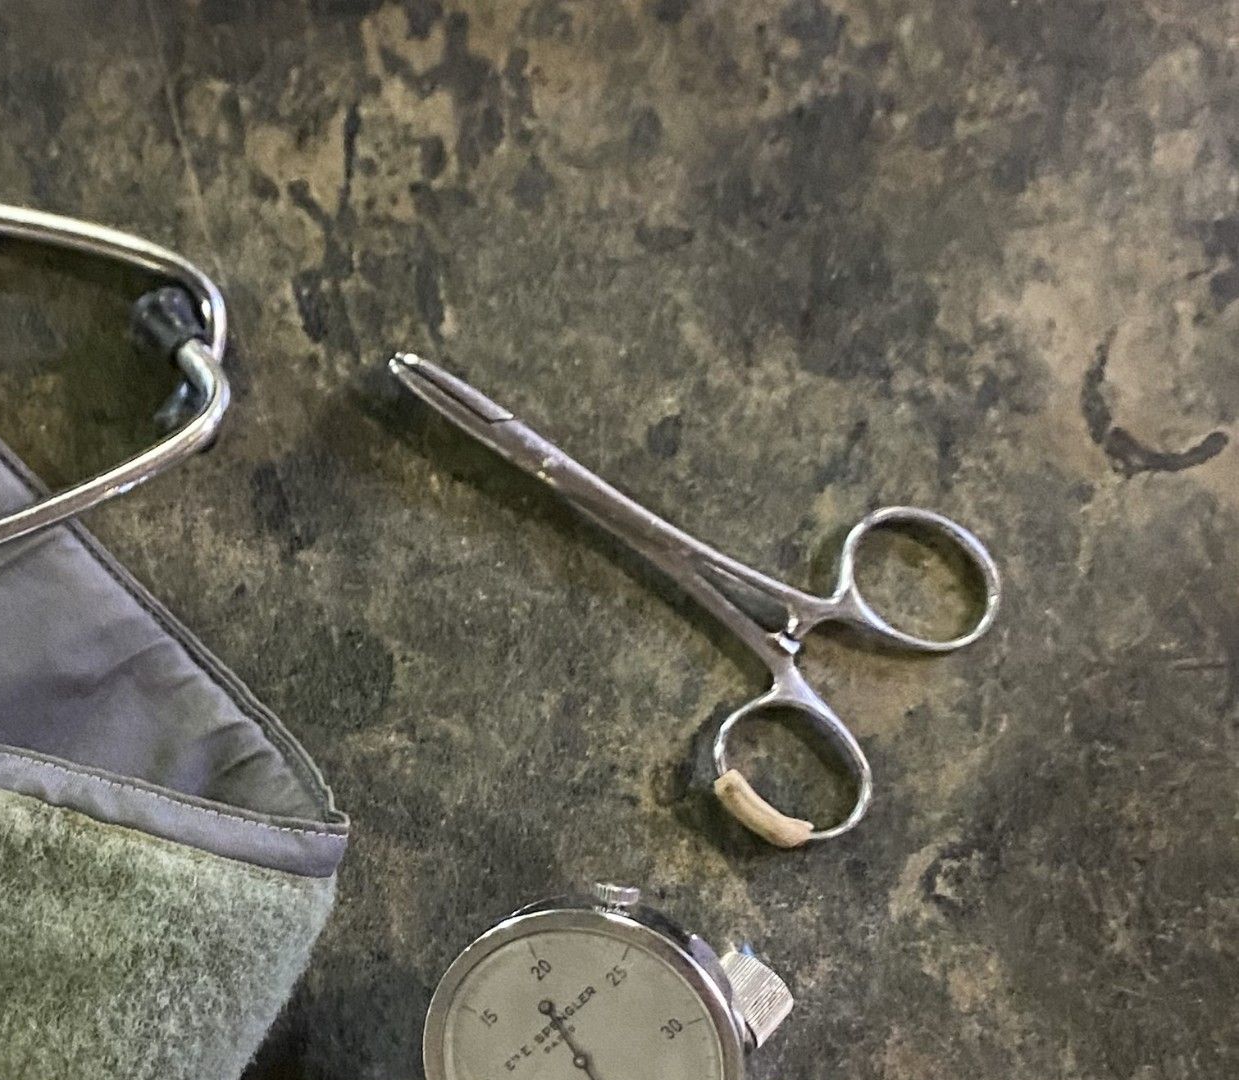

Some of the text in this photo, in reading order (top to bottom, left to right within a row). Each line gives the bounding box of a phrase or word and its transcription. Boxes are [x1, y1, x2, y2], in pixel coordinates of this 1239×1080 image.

[529, 958, 553, 982] 20
[605, 964, 629, 989] 25
[480, 1007, 500, 1029] 15
[660, 1017, 684, 1040] 30
